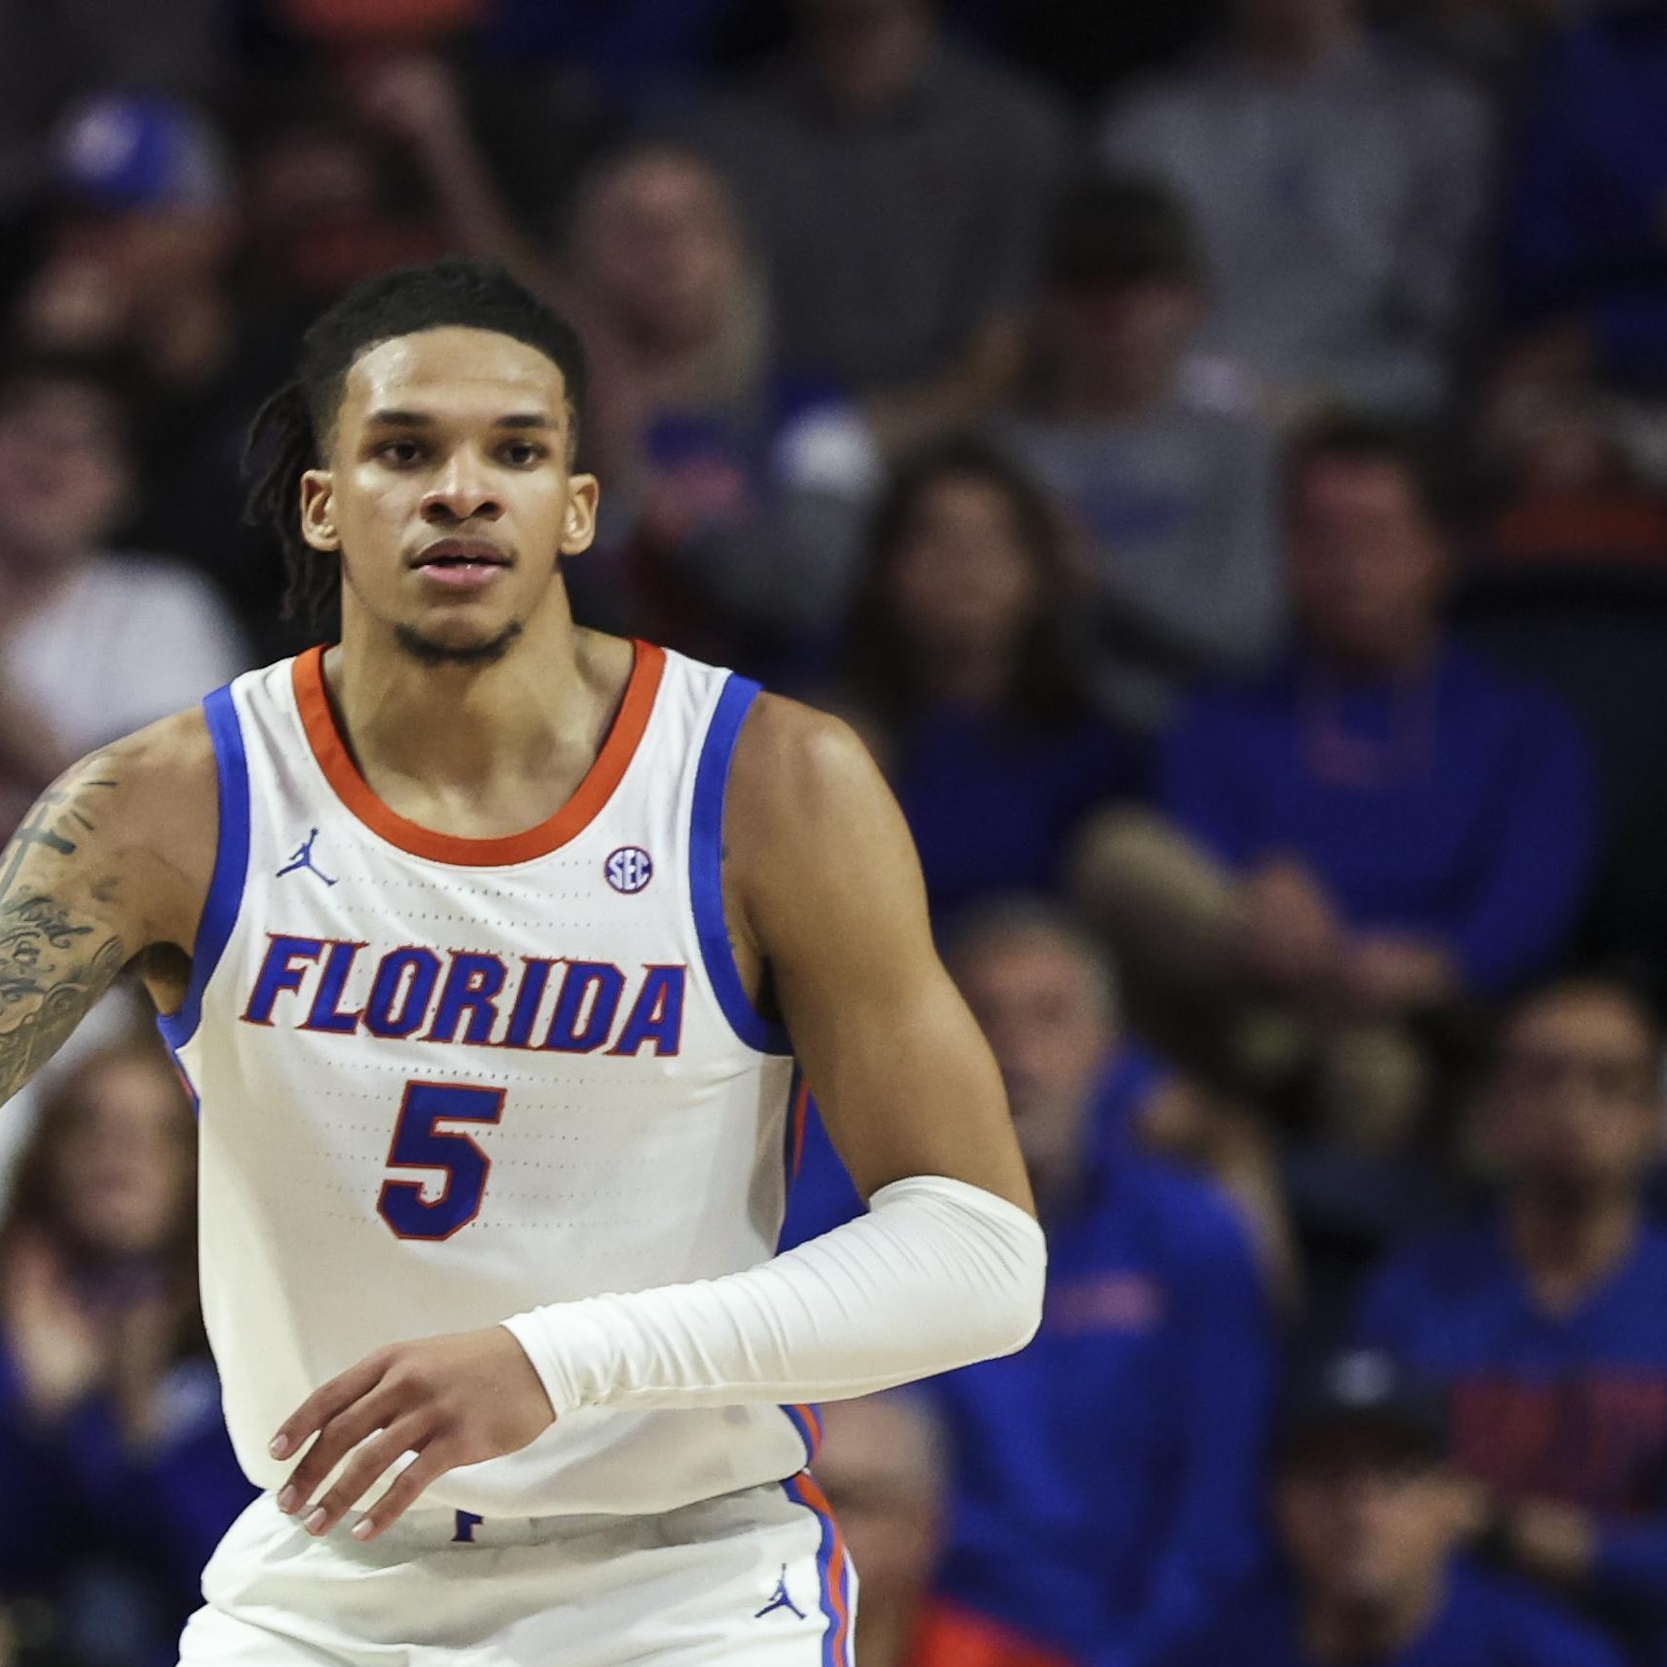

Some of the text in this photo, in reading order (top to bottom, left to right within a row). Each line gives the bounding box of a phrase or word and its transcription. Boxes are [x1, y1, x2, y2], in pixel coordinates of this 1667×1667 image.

[607, 849, 651, 891] SEC
[239, 933, 687, 1058] FLORIDA
[376, 1080, 508, 1242] 5
